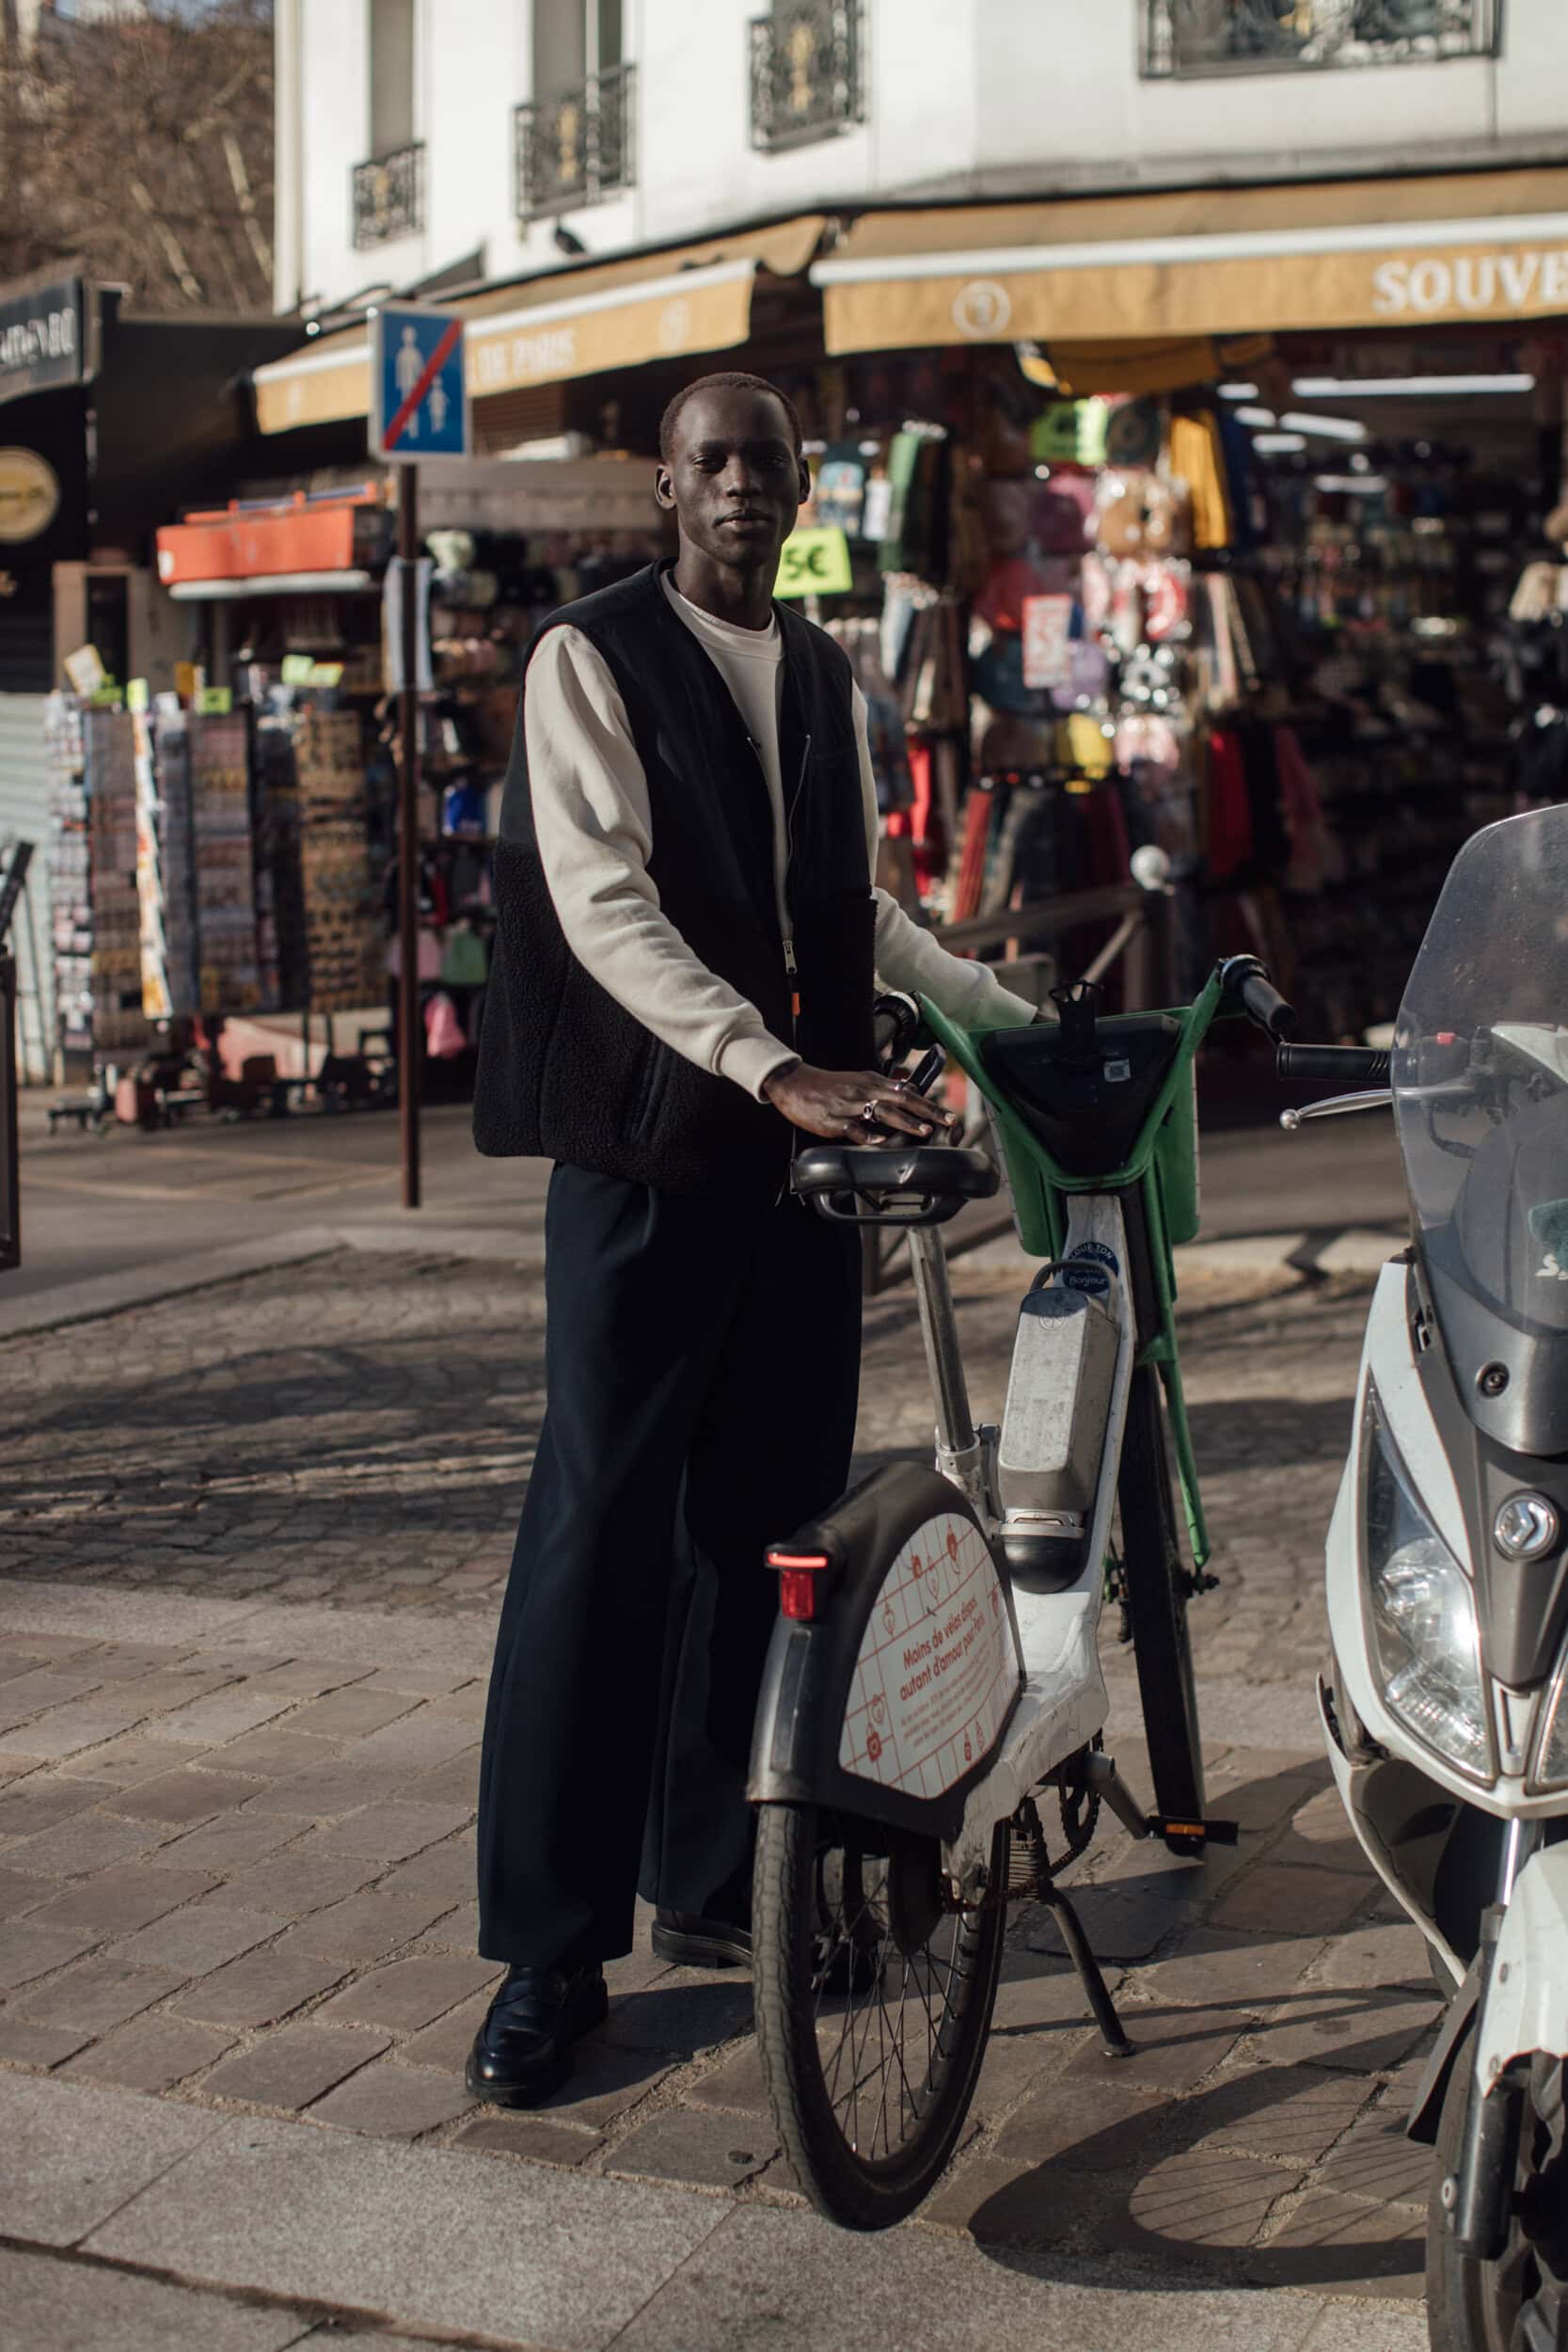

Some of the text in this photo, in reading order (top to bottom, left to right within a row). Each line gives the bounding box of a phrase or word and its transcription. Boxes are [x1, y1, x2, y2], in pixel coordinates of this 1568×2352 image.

[1370, 251, 1568, 316] SOUVE
[784, 545, 831, 580] 5€
[1069, 1275, 1107, 1287] Bonjour
[899, 1662, 932, 1702] autant
[933, 1640, 963, 1677] d'amour
[903, 1640, 932, 1672] Moins
[932, 1627, 943, 1649] de
[943, 1613, 962, 1639] vélos
